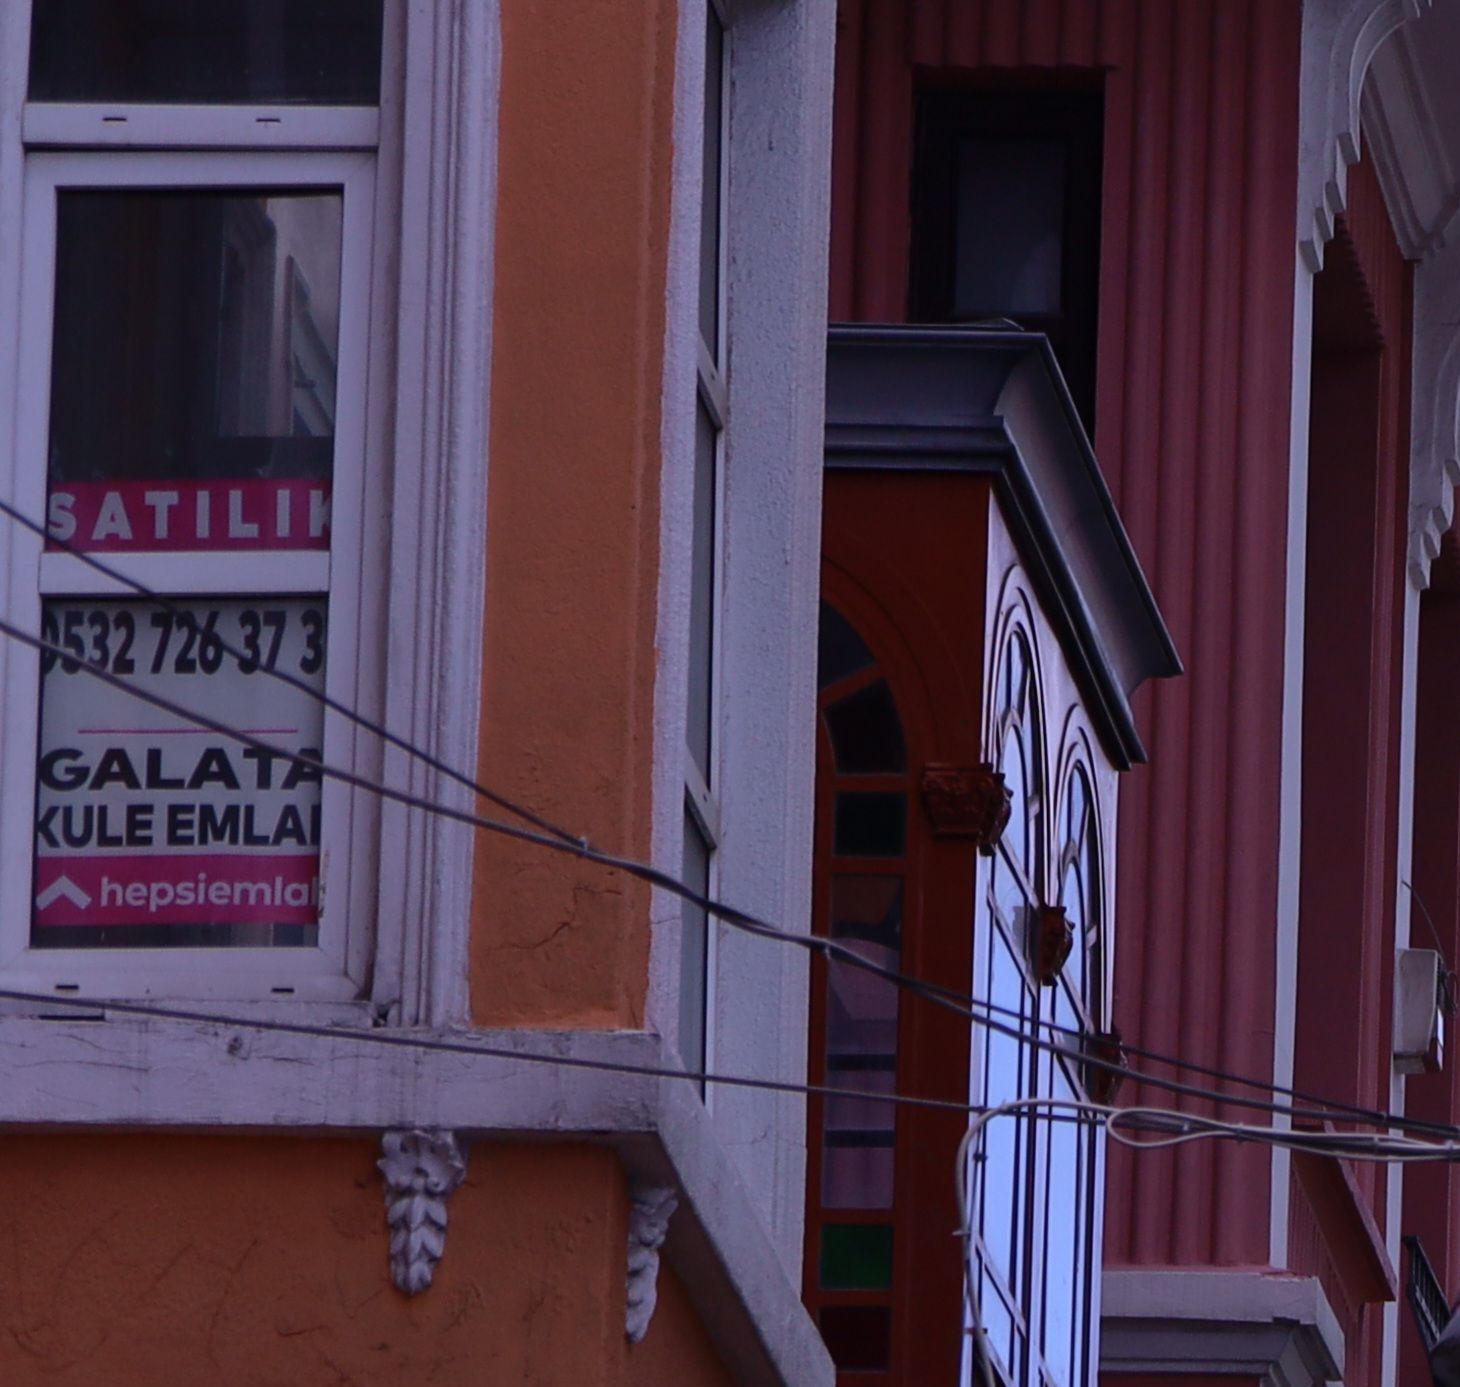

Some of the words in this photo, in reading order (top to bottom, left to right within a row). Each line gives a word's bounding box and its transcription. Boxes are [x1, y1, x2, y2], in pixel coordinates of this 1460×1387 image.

[150, 609, 224, 675] 726
[238, 609, 286, 674] 37
[39, 748, 322, 791] GALATA
[37, 804, 154, 848] KULE
[101, 873, 318, 912] hepsiemla
